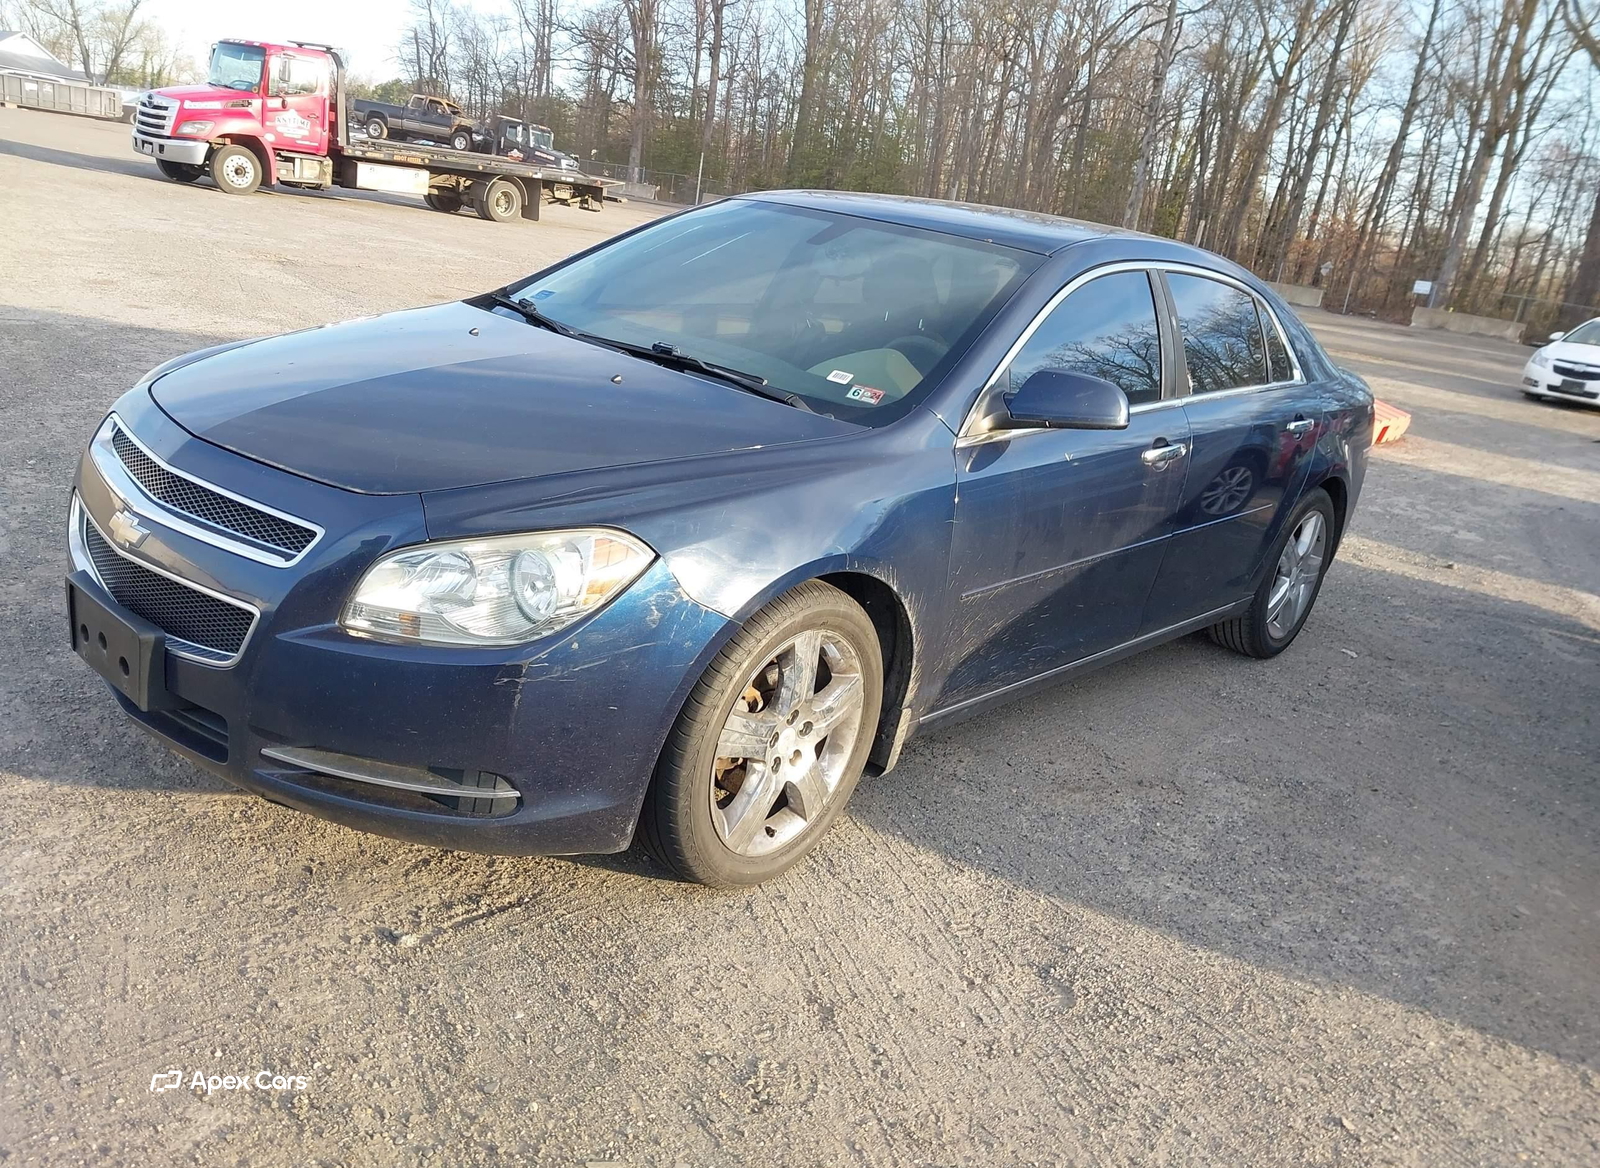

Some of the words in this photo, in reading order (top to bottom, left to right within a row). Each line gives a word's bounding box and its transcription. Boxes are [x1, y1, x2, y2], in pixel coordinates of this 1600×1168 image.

[276, 117, 309, 128] ANYTIME
[852, 388, 862, 397] 6
[870, 392, 881, 400] 24
